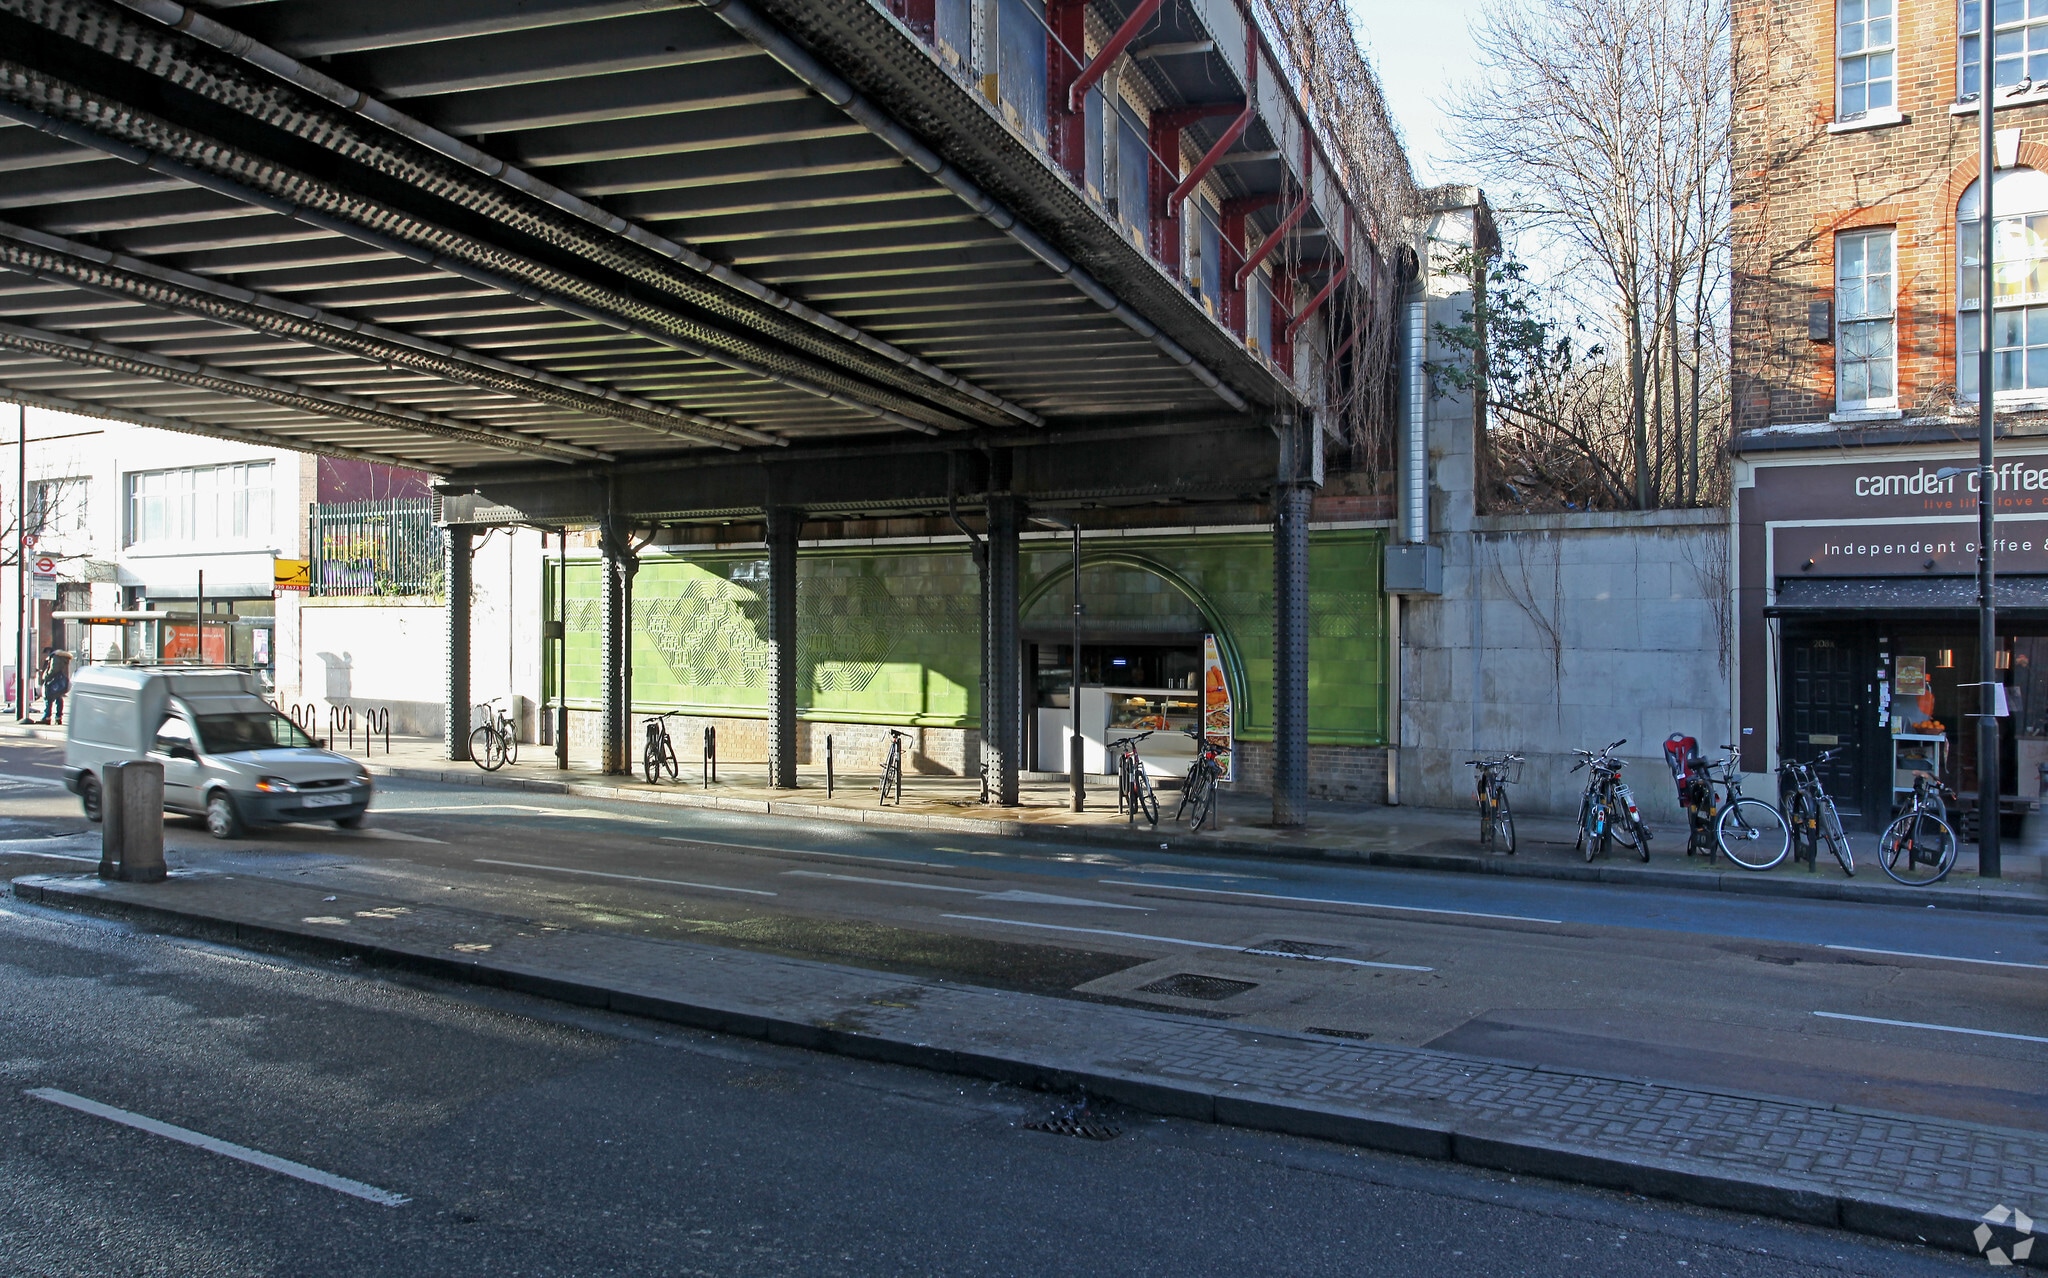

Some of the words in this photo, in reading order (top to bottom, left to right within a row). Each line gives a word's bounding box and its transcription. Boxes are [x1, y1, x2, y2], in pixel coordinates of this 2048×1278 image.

[1856, 468, 1953, 496] camden
[1924, 499, 1953, 509] live
[1998, 497, 2033, 507] love
[26, 536, 34, 546] B
[1824, 541, 1956, 557] Independent
[1966, 539, 2032, 552] cffee
